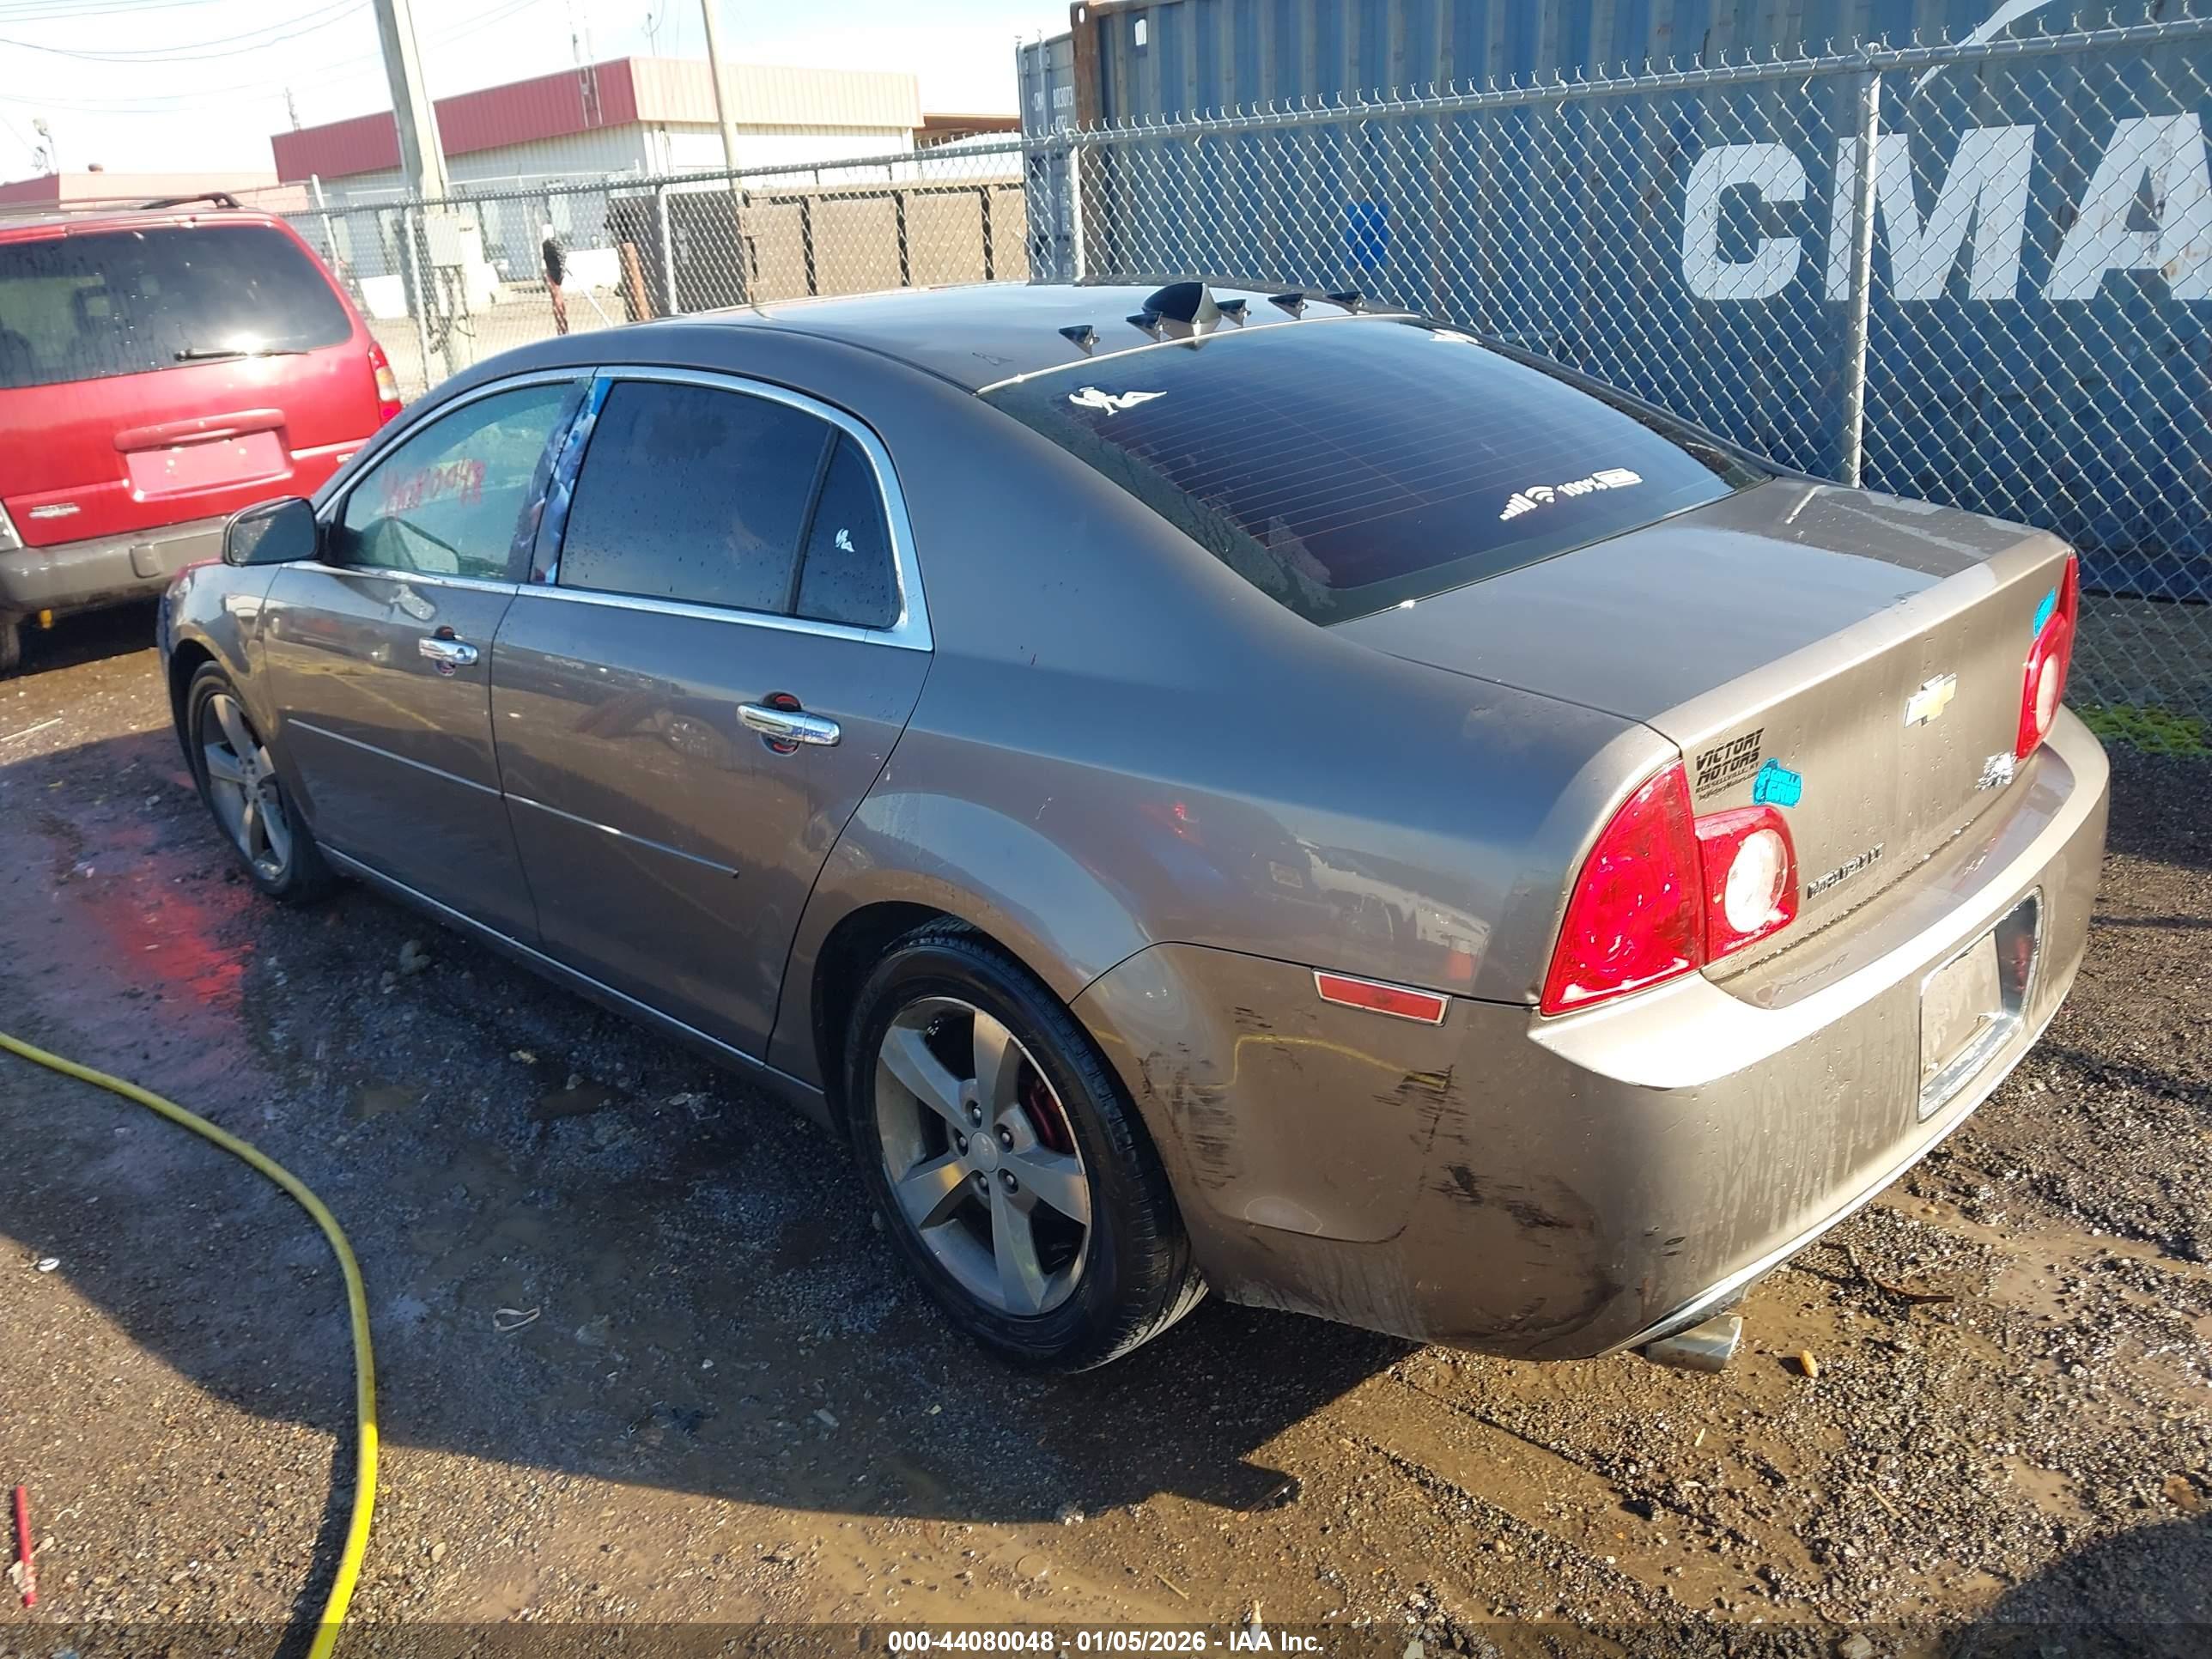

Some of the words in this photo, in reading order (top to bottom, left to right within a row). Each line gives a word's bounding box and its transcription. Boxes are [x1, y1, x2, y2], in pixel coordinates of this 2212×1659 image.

[1683, 112, 2212, 300] CMA
[1557, 477, 1608, 497] 100%
[1696, 727, 1765, 771] VICTORY
[1696, 746, 1761, 787] MOTORS
